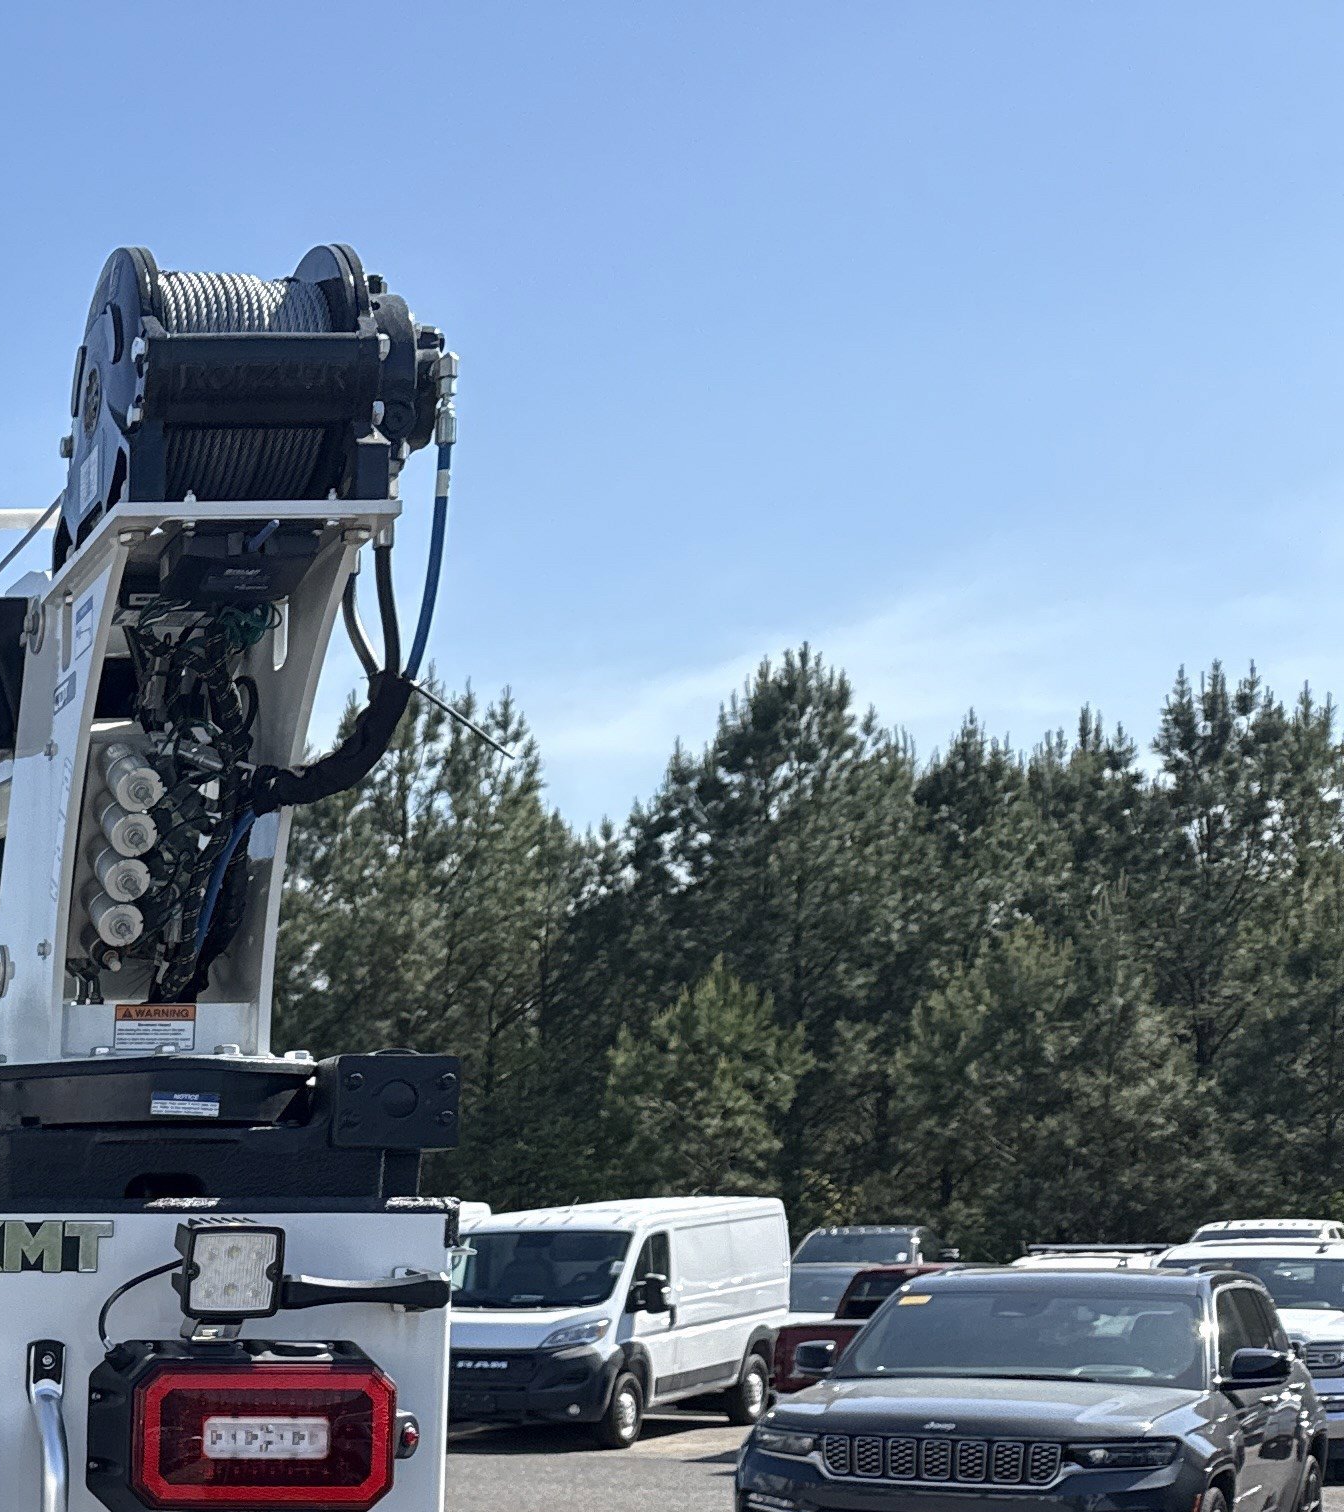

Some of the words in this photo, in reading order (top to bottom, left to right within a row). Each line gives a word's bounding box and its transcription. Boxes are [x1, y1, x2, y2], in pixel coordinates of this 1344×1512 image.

[135, 1008, 189, 1018] WARNING
[173, 1093, 200, 1101] NOTICE
[456, 1360, 508, 1369] RAM
